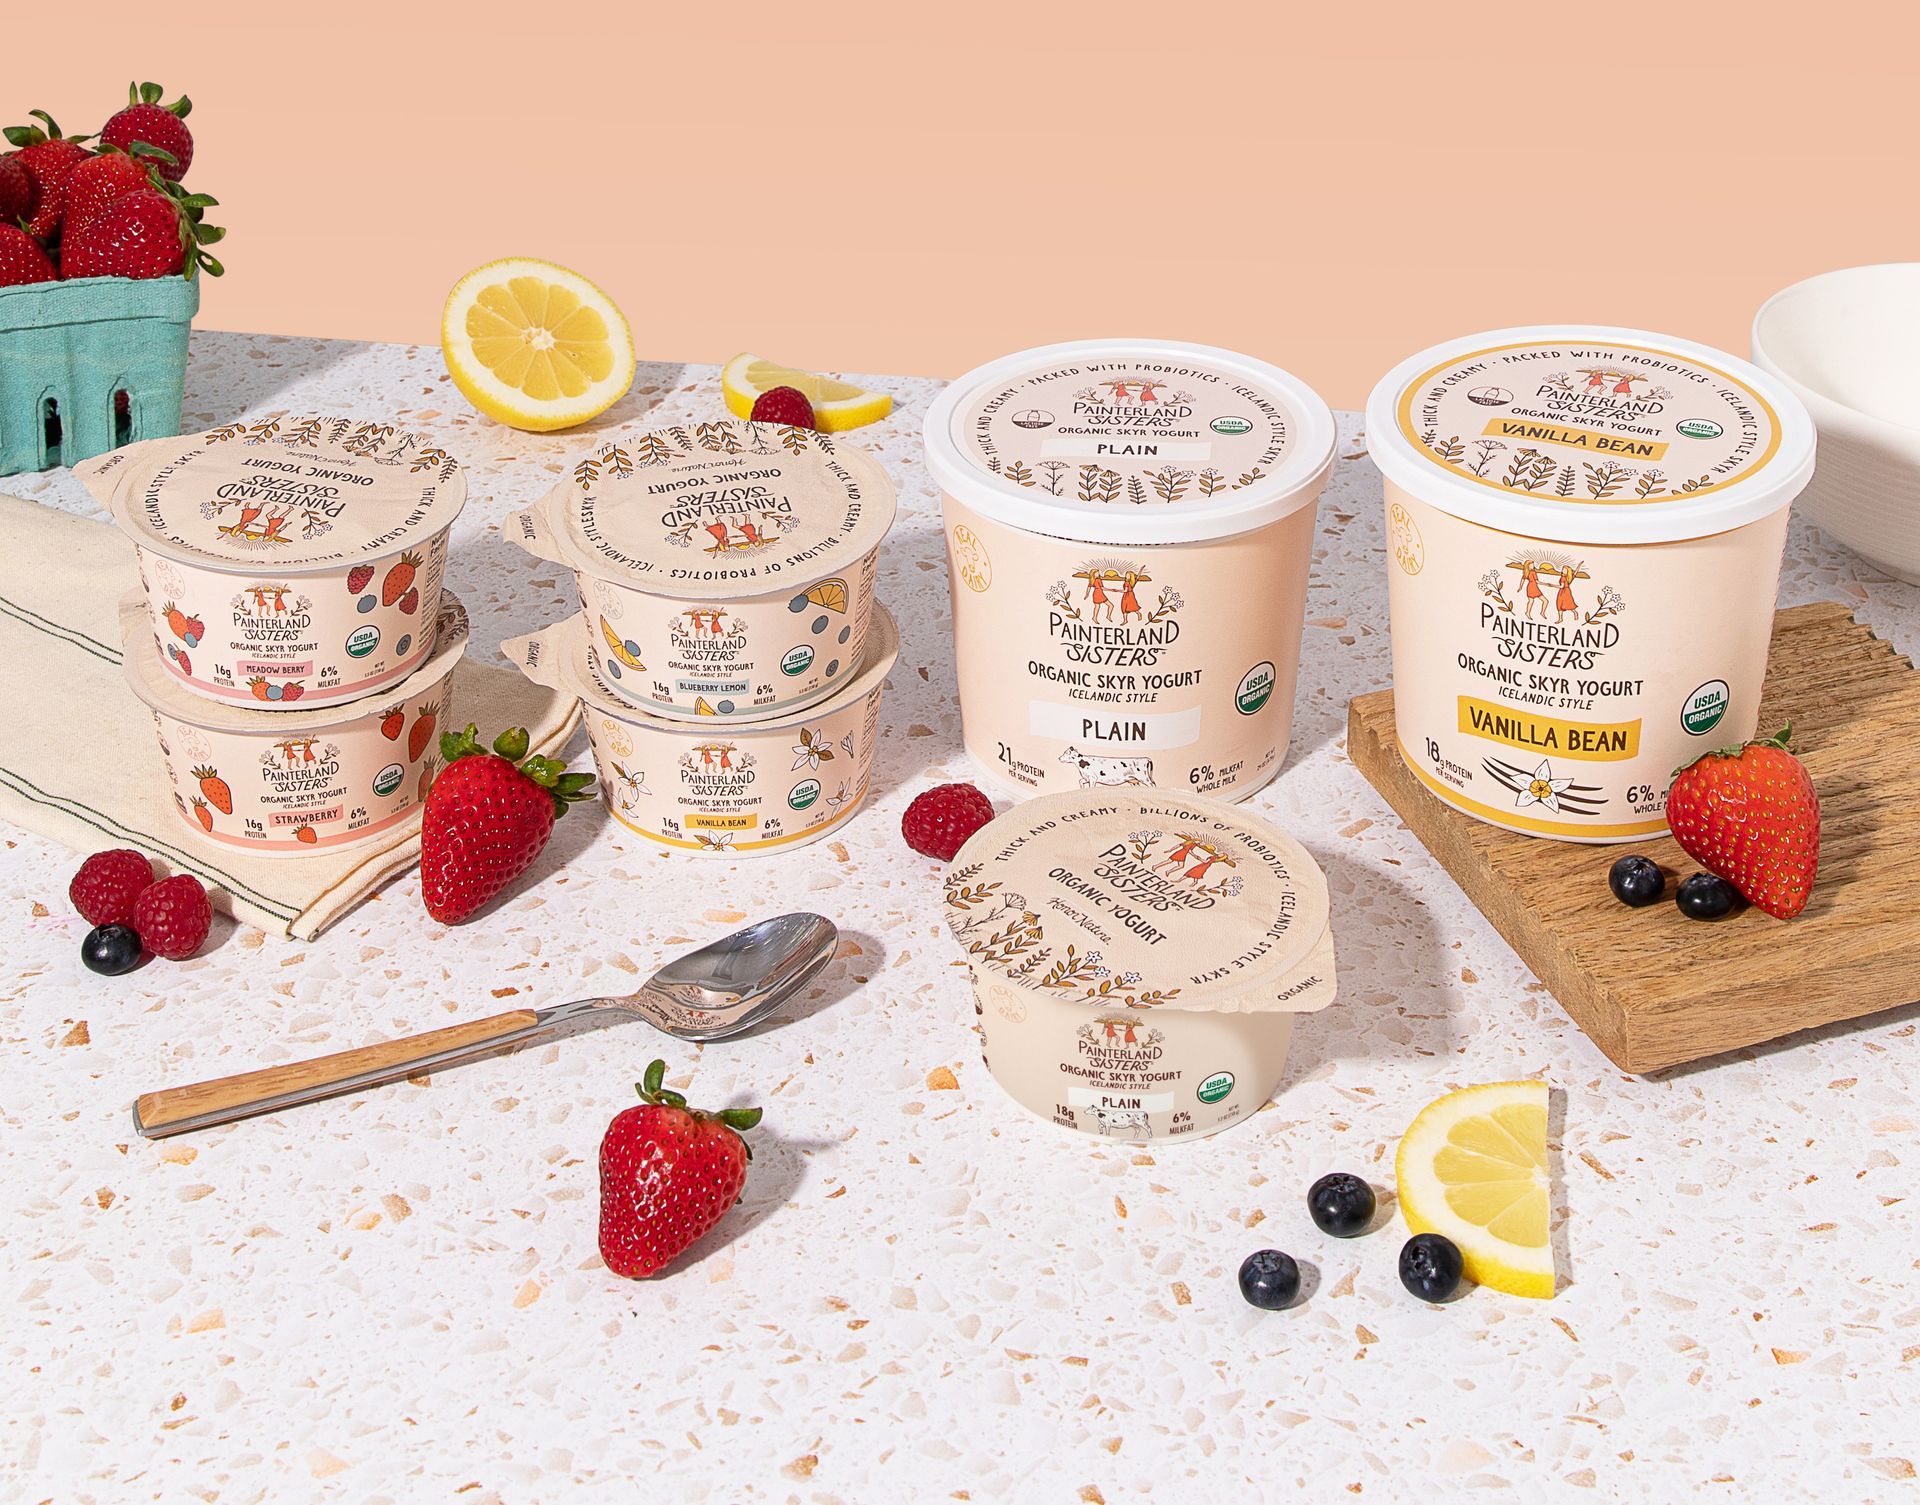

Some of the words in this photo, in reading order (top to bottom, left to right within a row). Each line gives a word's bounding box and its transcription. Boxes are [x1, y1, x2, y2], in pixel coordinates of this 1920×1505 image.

[1502, 351, 1560, 363] PACKED
[1570, 351, 1613, 359] WITH
[1028, 368, 1079, 385] PACKED
[1086, 364, 1126, 372] WITH
[1135, 364, 1220, 383] PROBIOTICS
[1442, 363, 1488, 386] CREAMY
[1622, 354, 1710, 383] PROBIOTICS
[983, 387, 1019, 414] CREAMY
[1231, 385, 1280, 420] ICELANDIC
[1428, 387, 1447, 402] AND
[1535, 385, 1664, 414] PAINTERLAND
[1073, 401, 1192, 418] PAINTERLAND
[1422, 404, 1438, 427] THICK
[1545, 399, 1641, 421] SISTERS
[1716, 389, 1757, 429] ICELANDIC
[977, 416, 992, 431] AND
[1083, 415, 1175, 427] SISTERS
[1511, 407, 1568, 422] ORGANIC
[1572, 416, 1604, 428] SKYR
[1610, 421, 1662, 437] YOGURT
[1058, 427, 1111, 435] ORGANIC
[1117, 428, 1146, 436] SKYR
[1152, 429, 1200, 437] YOGURT
[1270, 422, 1285, 444] STYLE
[1502, 422, 1587, 445] VANILLA
[1595, 437, 1654, 456] BEAN
[977, 433, 998, 455] THICK
[1097, 444, 1158, 455] PLAIN
[1734, 431, 1757, 455] STYLE
[241, 458, 304, 474] YOGURT
[825, 460, 852, 482] THICK
[1711, 455, 1743, 473] SKYR
[306, 466, 374, 486] ORGANIC
[713, 468, 782, 483] ORGANIC
[243, 474, 341, 499] SISTERS
[647, 478, 709, 495] YOGURT
[845, 483, 861, 500] AND
[217, 483, 346, 518] PAINTERLAND
[670, 486, 775, 508] SISTERS
[661, 496, 792, 527] PAINTERLAND
[840, 503, 862, 533] CREAMY
[361, 527, 407, 551] CREAMY
[596, 541, 654, 572] ICELANDIC
[785, 536, 840, 567] BILLIONS
[669, 567, 757, 580] PROBIOTICS
[764, 563, 781, 574] OF
[233, 612, 311, 630] PAINTERLAND
[1049, 611, 1180, 645] PAINTERLAND
[1481, 602, 1620, 649] PAINTERLAND
[242, 629, 301, 641] SISTERS
[671, 633, 747, 650] PAINTERLAND
[230, 642, 262, 652] ORGANIC
[265, 643, 285, 652] SKYR
[287, 643, 318, 652] YOGURT
[679, 649, 738, 662] SISTERS
[1060, 643, 1166, 667] SISTERS
[1492, 636, 1605, 670] SISTERS
[215, 664, 231, 678] 16g
[246, 665, 280, 674] MEADOW
[282, 665, 305, 674] BERRY
[321, 666, 338, 677] 6%
[668, 661, 700, 671] ORGANIC
[702, 663, 722, 672] SKYR
[724, 662, 754, 671] YOGURT
[1028, 660, 1091, 687] ORGANIC
[1097, 674, 1136, 690] SKYR
[1142, 669, 1202, 690] YOGURT
[1457, 652, 1522, 687] ORGANIC
[1529, 674, 1570, 695] SKYR
[1577, 680, 1644, 697] YOGURT
[213, 676, 235, 687] PROTEIN
[317, 678, 341, 688] MILKFAT
[653, 681, 670, 695] 16g
[680, 682, 718, 692] BLUEBERRY
[721, 684, 746, 692] LEMON
[756, 684, 773, 695] 6%
[1246, 671, 1269, 691] USDA
[1069, 688, 1122, 703] ICELANDIC
[1126, 692, 1159, 703] STYLE
[1242, 684, 1270, 705] ORGANIC
[1498, 685, 1554, 707] ICELANDIC
[1558, 698, 1594, 711] STYLE
[1694, 690, 1720, 709] USDA
[1688, 704, 1723, 724] ORGANIC
[1082, 718, 1146, 741] PLAIN
[1469, 705, 1559, 749] VANILLA
[1568, 728, 1627, 752] BEAN
[262, 761, 339, 782] PAINTERLAND
[681, 769, 755, 785] PAINTERLAND
[1017, 761, 1045, 778] PROTEIN
[1189, 764, 1214, 784] 6%
[1219, 760, 1244, 777] MILKFAT
[1445, 760, 1473, 781] PROTEIN
[271, 777, 330, 792] SISTERS
[689, 785, 745, 796] SISTERS
[1196, 779, 1220, 794] WHOLE
[1222, 774, 1237, 786] MILK
[260, 795, 294, 803] ORGANIC
[296, 793, 316, 802] SKYR
[317, 787, 348, 799] YOGURT
[677, 797, 709, 806] ORGANIC
[711, 799, 730, 807] SKYR
[733, 797, 762, 806] YOGURT
[1626, 785, 1654, 804] 6%
[350, 806, 367, 819] 6%
[1061, 807, 1118, 822] CREAMY
[1139, 807, 1209, 822] BILLIONS
[1634, 801, 1662, 814] WHOLE
[245, 818, 263, 831] 16g
[275, 809, 338, 824] STRAWBERRY
[663, 817, 679, 831] 16g
[696, 819, 725, 827] VANILLA
[764, 818, 780, 830] 6%
[244, 830, 267, 839] PROTEIN
[661, 828, 683, 839] PROTEIN
[1029, 821, 1056, 836] AND
[1213, 823, 1234, 832] OF
[995, 836, 1030, 862] THICK
[1233, 832, 1290, 881] PROBIOTICS
[1098, 843, 1216, 910] PAINTERLAND
[1094, 862, 1184, 912] SISTERS
[1046, 897, 1080, 920] Honor
[1048, 867, 1112, 906] ORGANIC
[1107, 904, 1167, 945] YOGURT
[1266, 890, 1296, 940] ICELANDIC
[1231, 941, 1273, 968] STYLE
[1189, 967, 1231, 985] SKYR
[1277, 975, 1323, 1001] ORGANIC
[1079, 1040, 1162, 1060] PAINTERLAND
[1060, 1063, 1105, 1080] ORGANIC
[1109, 1072, 1136, 1081] SKYR
[1140, 1070, 1182, 1081] YOGURT
[1086, 1057, 1151, 1071] SISTERS
[1089, 1080, 1127, 1089] ICELANDIC
[1202, 1086, 1231, 1098] ORGANIC
[1206, 1077, 1228, 1090] USDA
[1102, 1096, 1141, 1109] PLAIN
[1056, 1103, 1074, 1121] 18g
[1173, 1111, 1191, 1123] 6%
[1053, 1115, 1078, 1130] PROTEIN
[1169, 1123, 1194, 1135] MILKFAT
